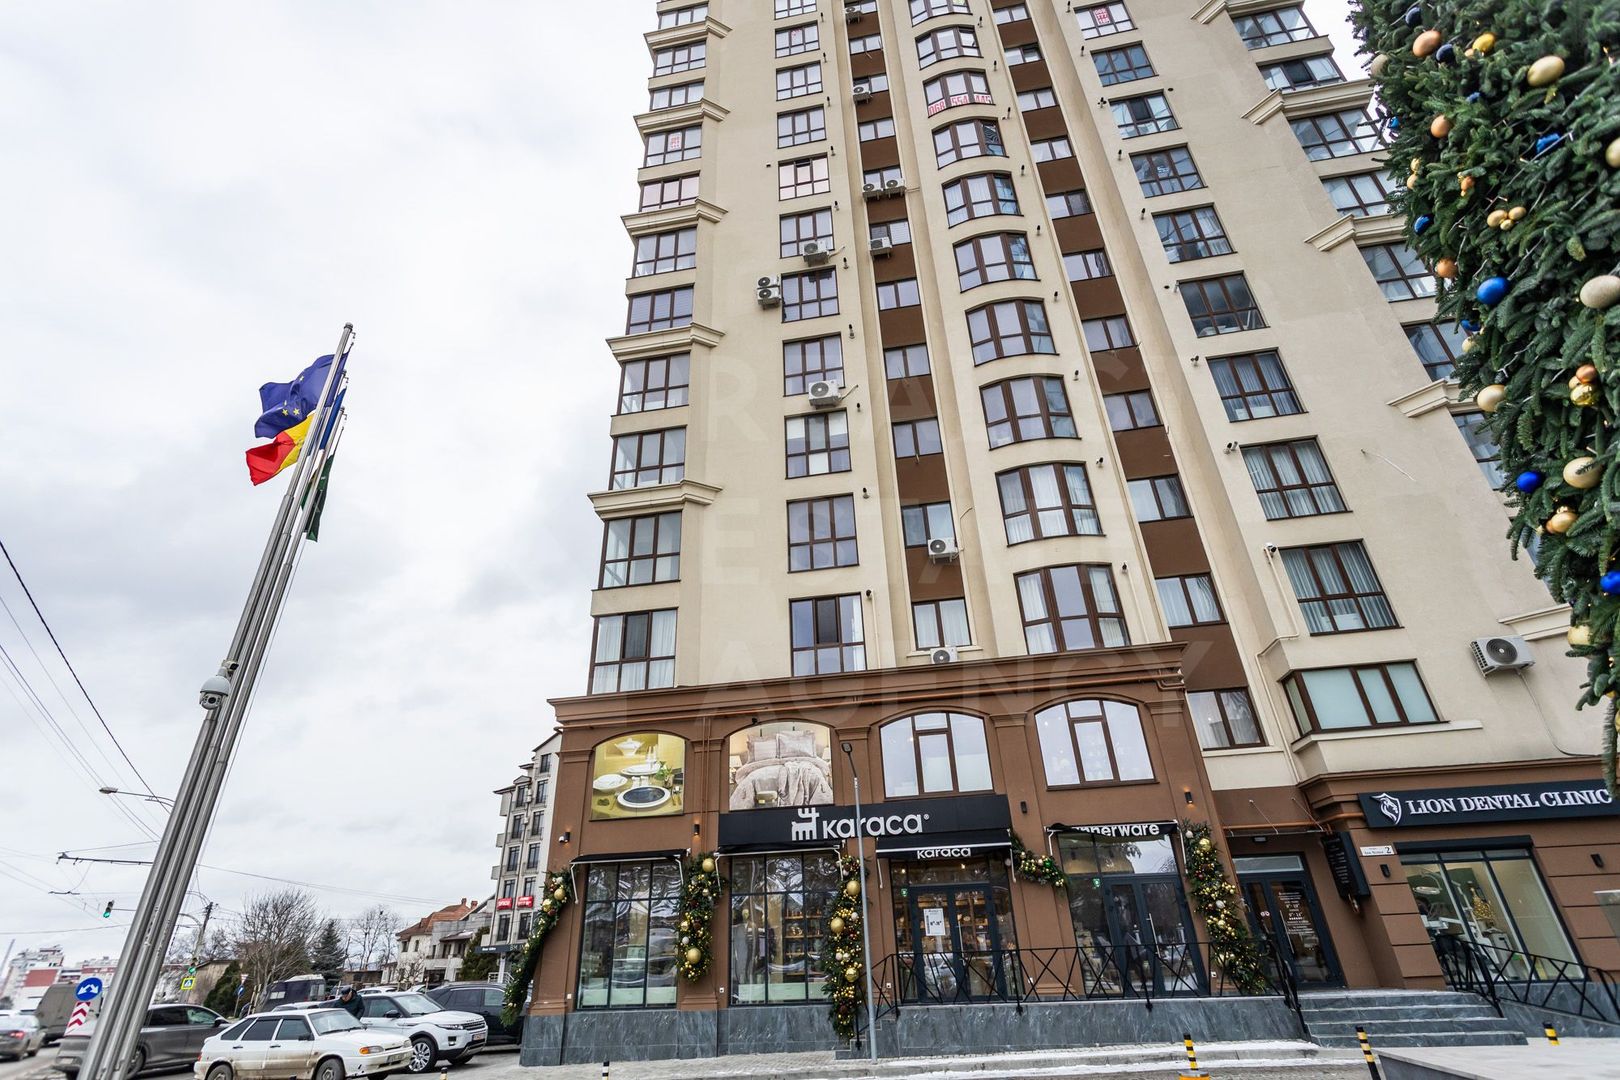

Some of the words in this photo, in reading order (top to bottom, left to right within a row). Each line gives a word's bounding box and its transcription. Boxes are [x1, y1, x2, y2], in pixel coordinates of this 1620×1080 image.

[1405, 798, 1457, 815] LION
[1457, 793, 1541, 812] DENTAL
[1540, 788, 1612, 807] CLINIC
[1385, 846, 1391, 854] 2
